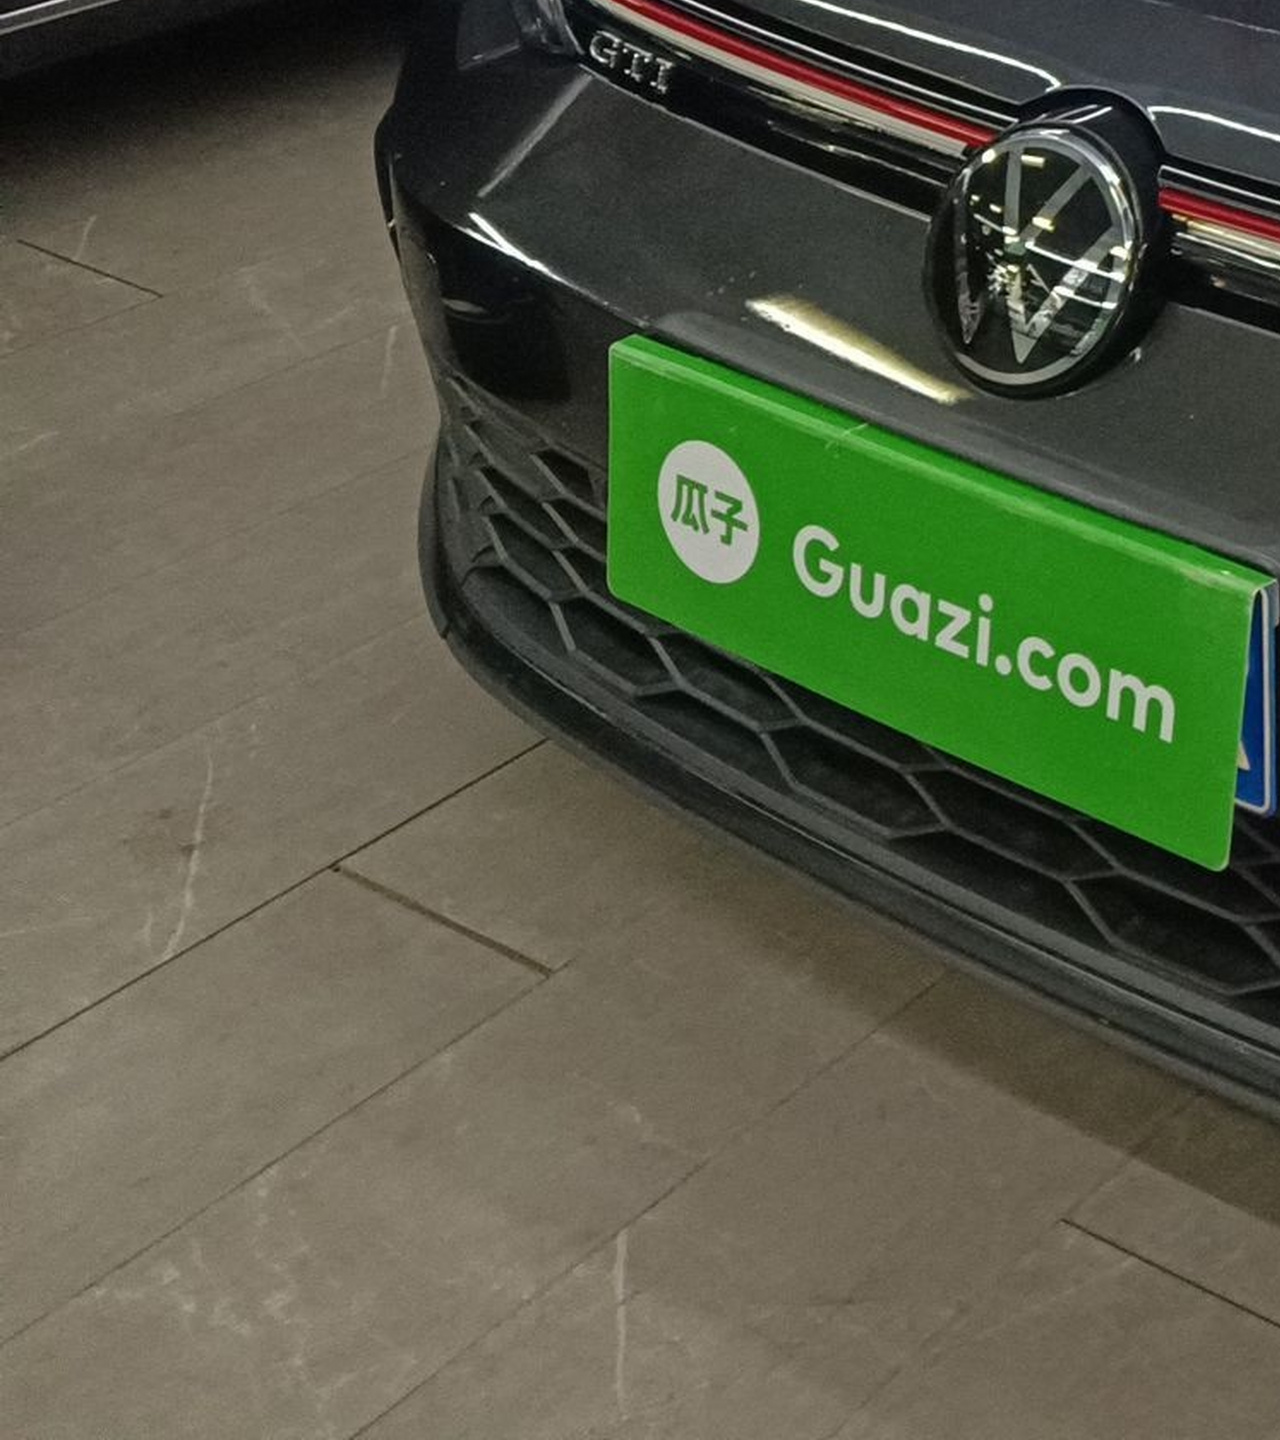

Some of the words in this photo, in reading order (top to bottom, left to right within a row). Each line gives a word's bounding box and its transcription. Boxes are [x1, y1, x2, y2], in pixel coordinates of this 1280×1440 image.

[589, 29, 674, 95] GTI
[671, 473, 749, 546] 瓜子
[793, 524, 1176, 744] Guazi.com
